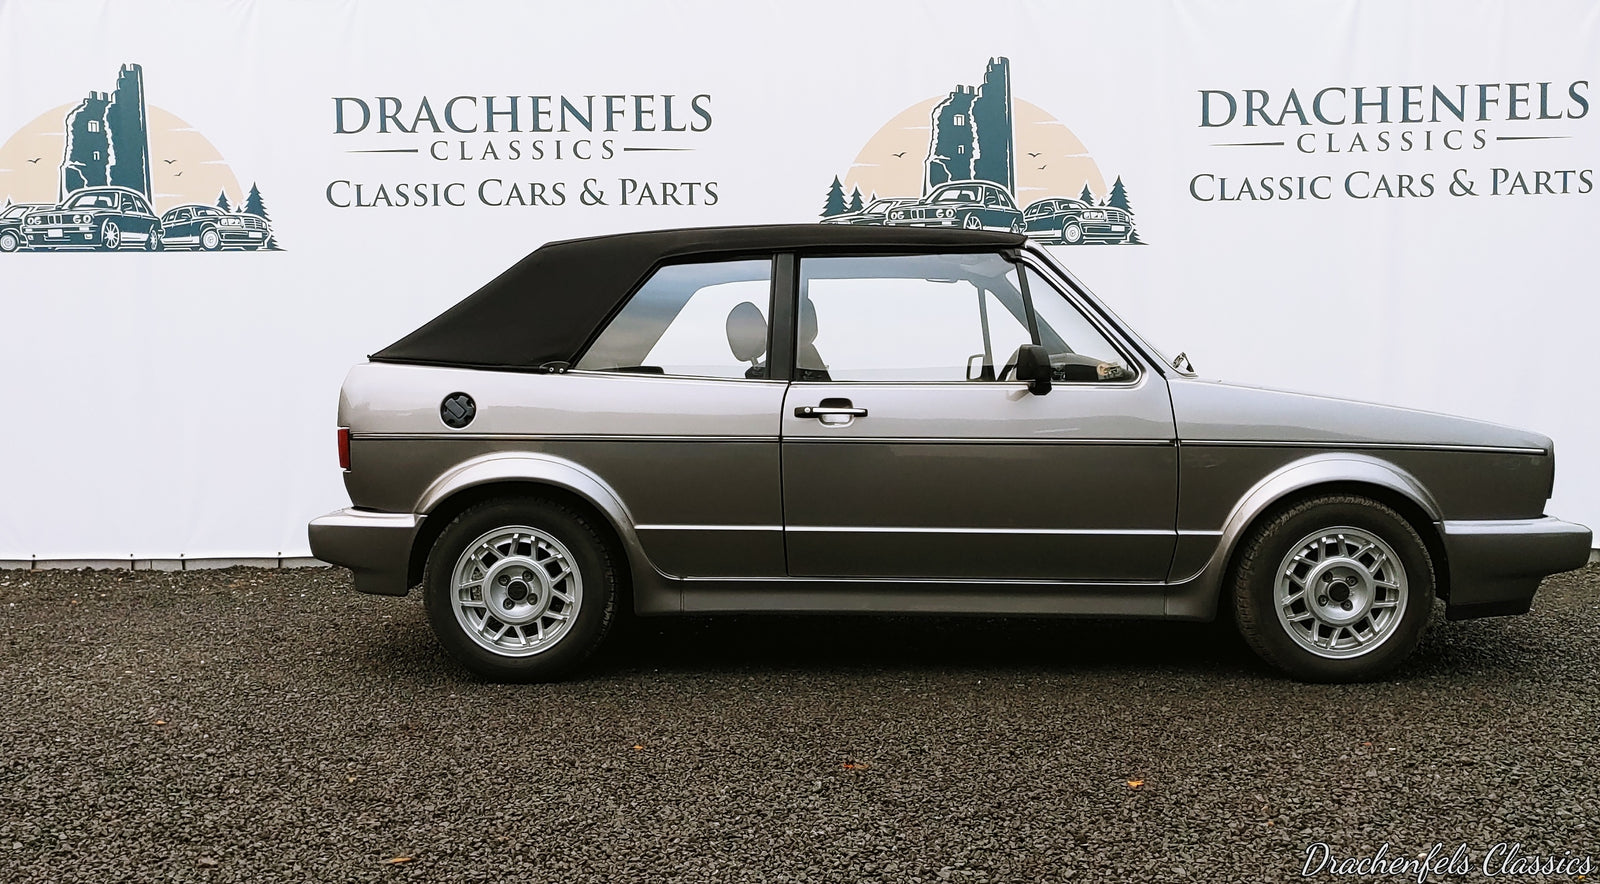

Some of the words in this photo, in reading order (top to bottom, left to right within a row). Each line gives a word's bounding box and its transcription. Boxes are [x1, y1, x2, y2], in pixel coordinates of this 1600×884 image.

[332, 95, 712, 134] DRACHENFELS
[1198, 81, 1589, 128] DRACHENFELS
[430, 139, 614, 161] CLASSICS
[1296, 128, 1486, 153] CLASSICS
[326, 179, 466, 208] CLASSIC
[477, 179, 566, 207] CARS
[580, 179, 608, 206] &
[620, 179, 719, 206] PARTS
[1189, 173, 1332, 202] CLASSIC
[1344, 171, 1435, 200] CARS
[1449, 169, 1479, 197] &
[1490, 168, 1593, 196] PARTS
